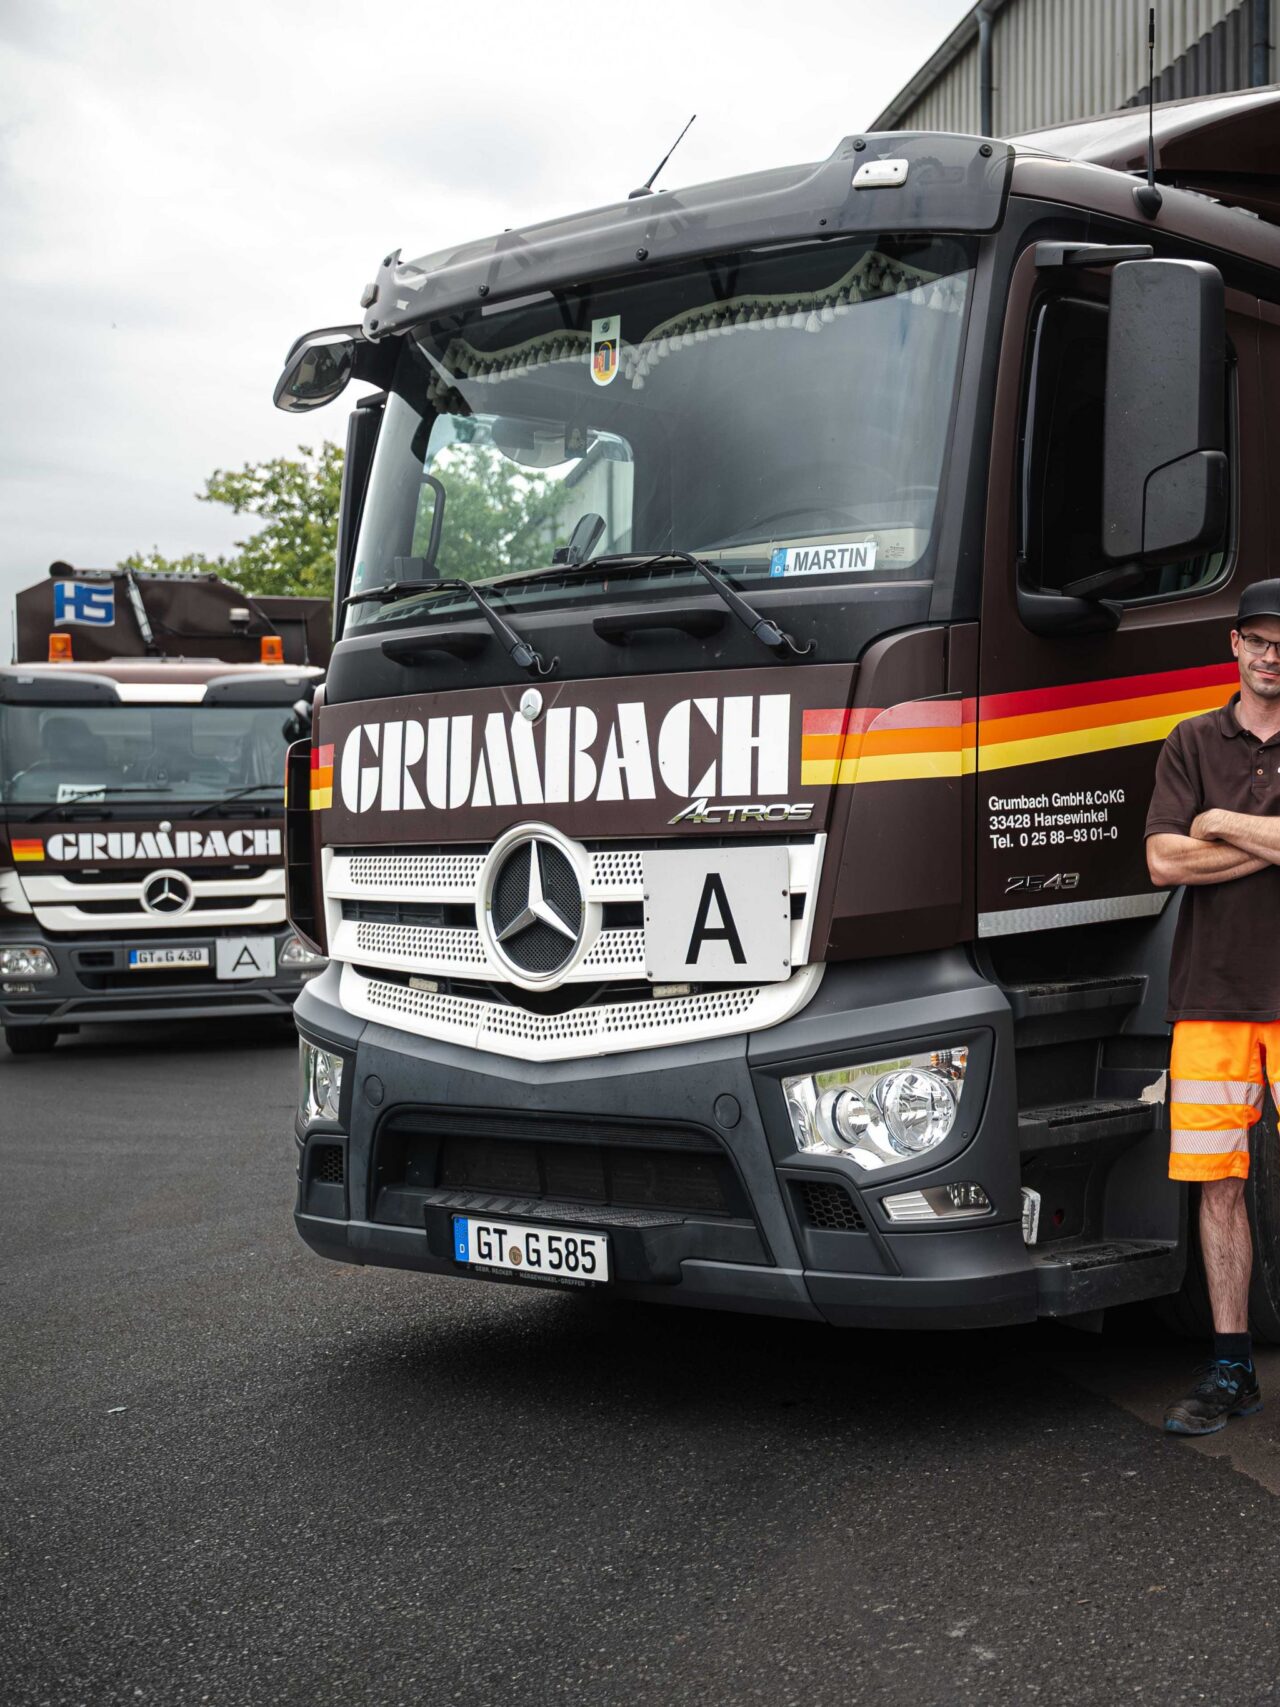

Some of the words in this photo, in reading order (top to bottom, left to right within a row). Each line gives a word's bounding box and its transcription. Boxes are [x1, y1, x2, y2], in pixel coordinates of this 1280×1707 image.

[793, 546, 868, 572] MARTIN
[55, 583, 113, 624] HS
[341, 694, 790, 813] GRUMBACH
[988, 794, 1049, 811] Grumbach
[989, 814, 1031, 830] 33428
[1034, 809, 1108, 827] Harsewinkel
[47, 829, 282, 861] GRUMBACH
[990, 833, 1014, 849] Tel.
[685, 873, 747, 964] A
[139, 951, 154, 963] GT
[166, 951, 175, 962] G
[178, 950, 202, 962] 430
[232, 944, 261, 972] A
[477, 1226, 507, 1262] GT
[548, 1234, 596, 1274] 585
